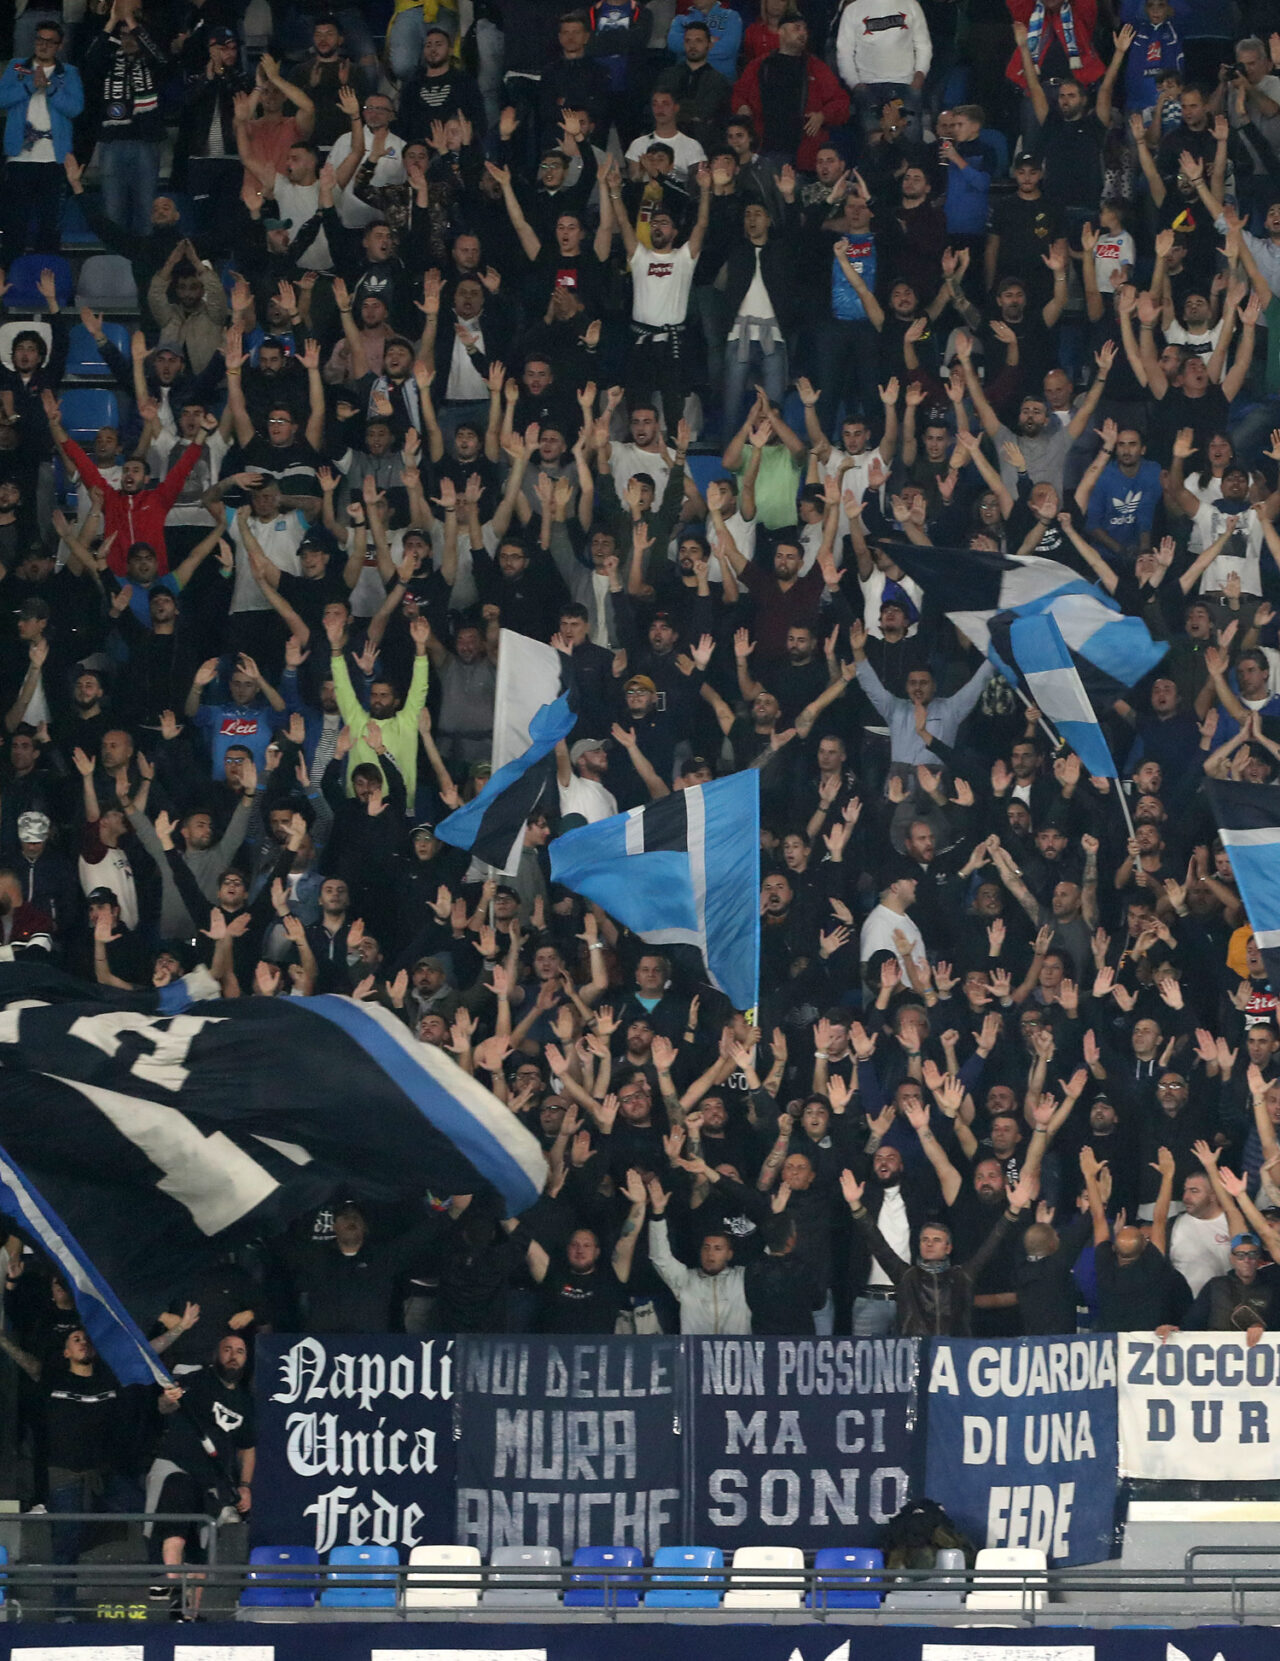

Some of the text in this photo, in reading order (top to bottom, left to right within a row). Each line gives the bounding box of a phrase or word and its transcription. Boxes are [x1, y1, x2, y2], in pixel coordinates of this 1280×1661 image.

[269, 1337, 455, 1412] Napoli
[463, 1343, 673, 1398] NOI DELLE
[702, 1339, 915, 1395] NON POSSONO
[928, 1339, 1117, 1397] A GUARDIA
[285, 1412, 438, 1477] Unica
[494, 1409, 636, 1480] MURA
[725, 1409, 886, 1455] MA CI
[962, 1410, 1096, 1466] DI UNA
[303, 1485, 425, 1554] Fede
[456, 1488, 680, 1558] ANTICHE
[708, 1467, 908, 1527] SONO
[986, 1482, 1075, 1559] FEDE
